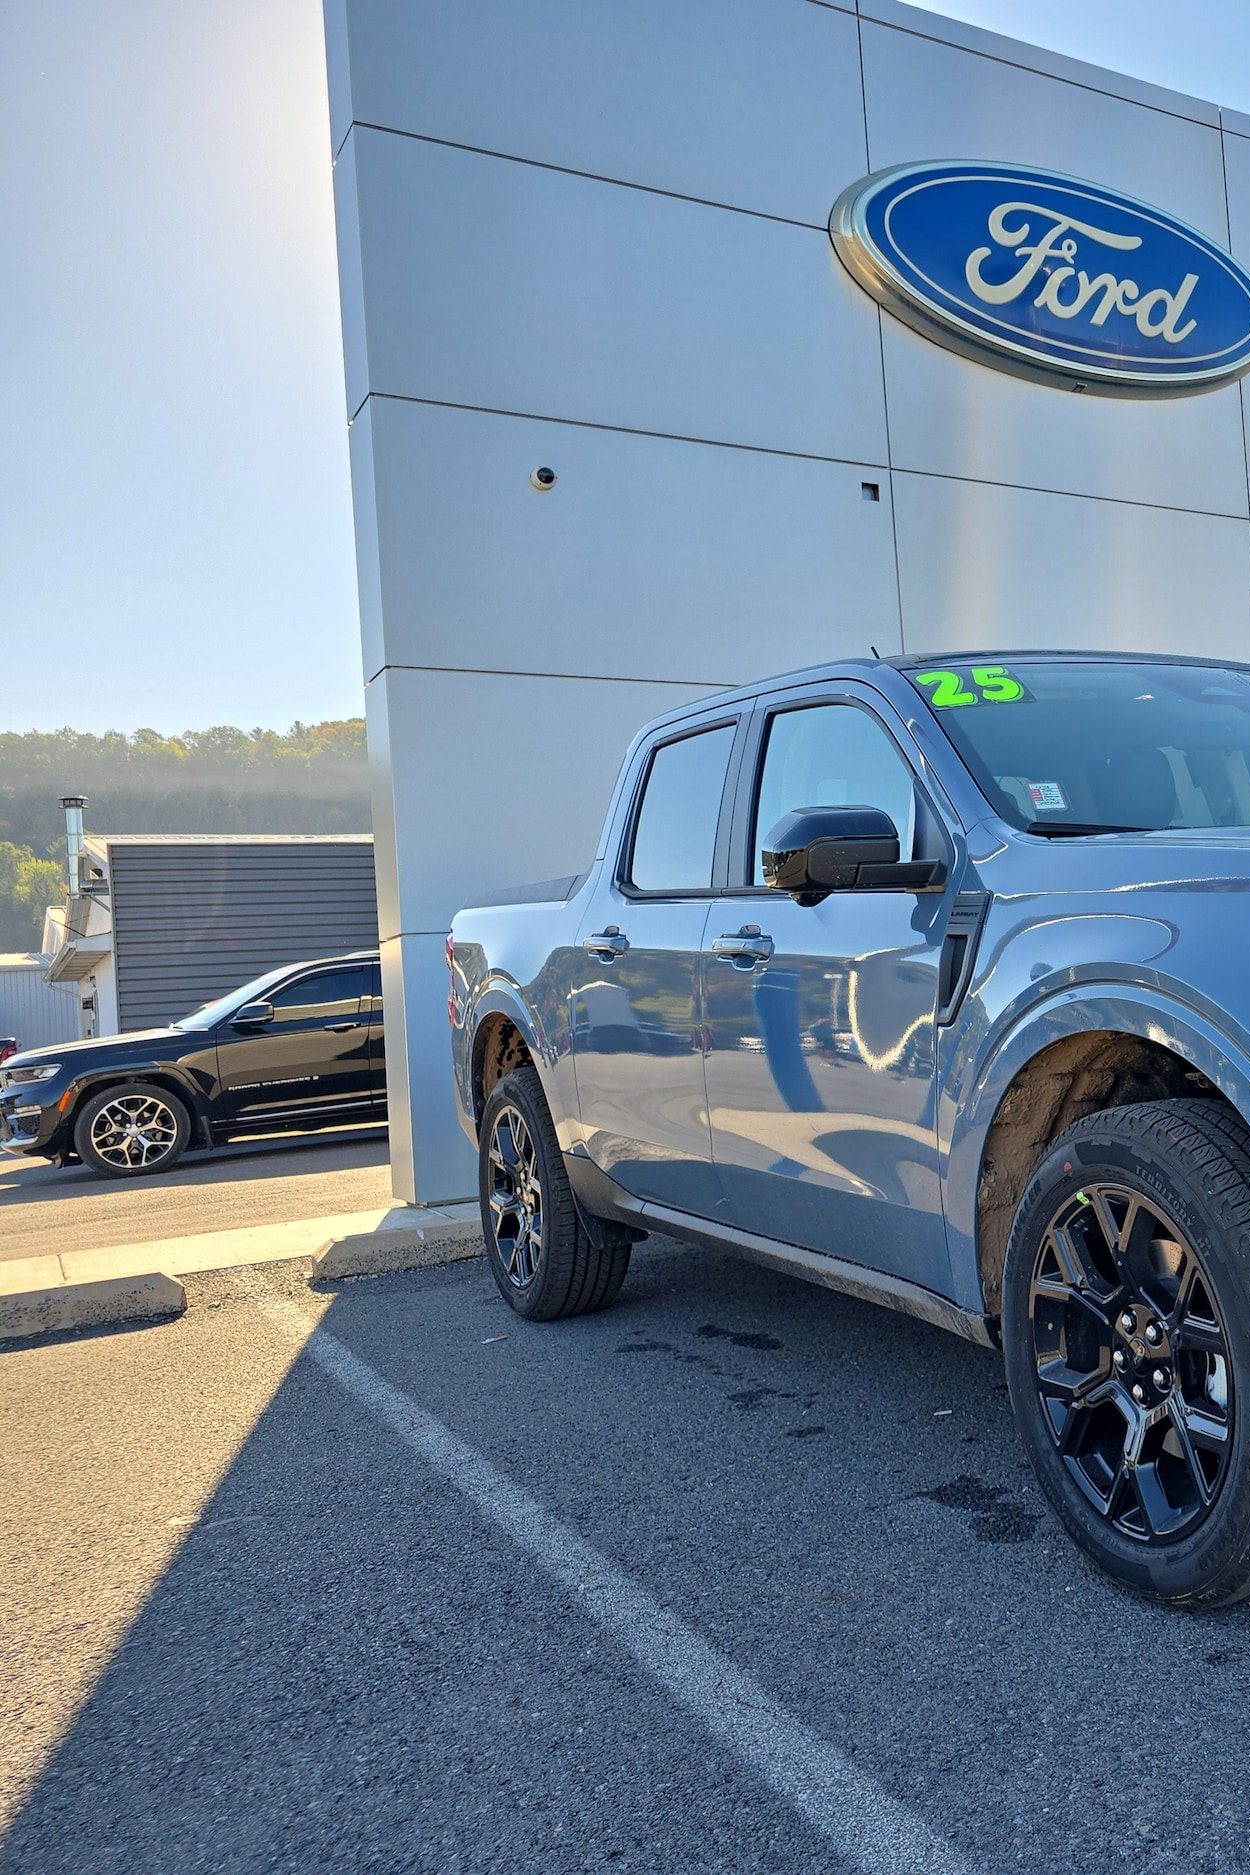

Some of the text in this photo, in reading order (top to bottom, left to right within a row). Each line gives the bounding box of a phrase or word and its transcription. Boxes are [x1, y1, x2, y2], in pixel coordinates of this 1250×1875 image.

[965, 201, 1200, 344] Ford
[915, 667, 1025, 707] 25
[1134, 1164, 1195, 1227] TERRITORY
